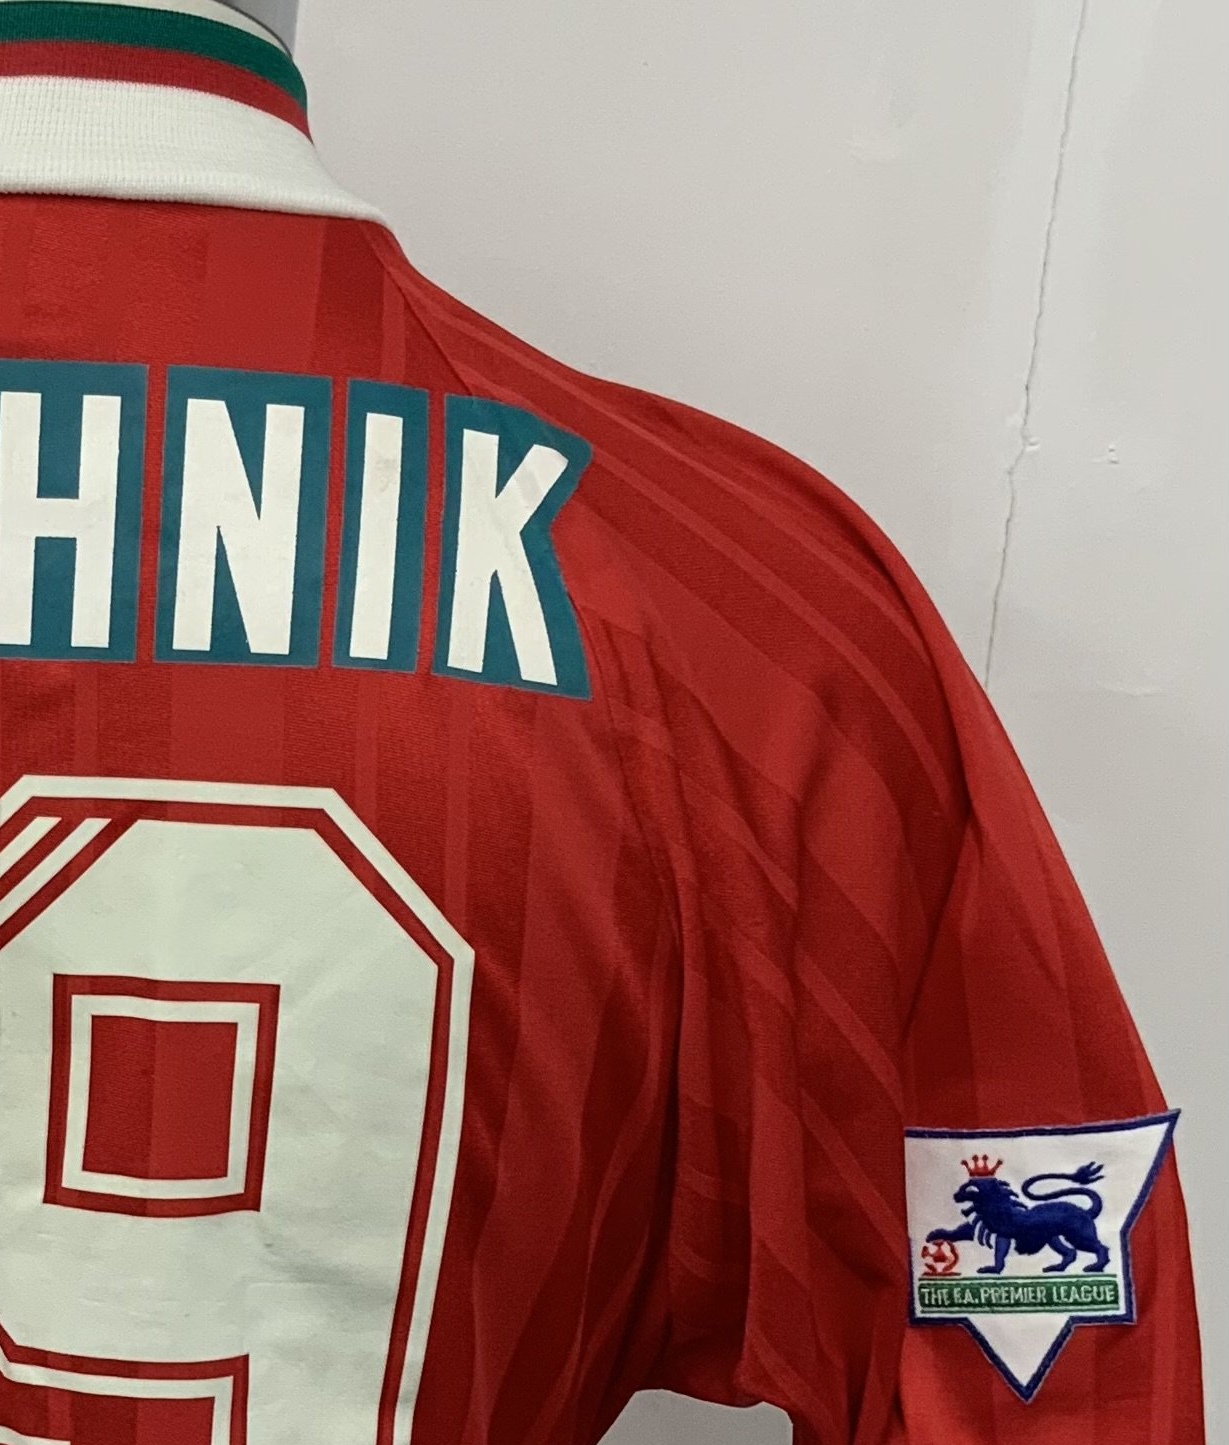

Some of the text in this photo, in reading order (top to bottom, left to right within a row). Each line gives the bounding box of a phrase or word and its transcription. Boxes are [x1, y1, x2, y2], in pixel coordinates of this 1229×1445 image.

[920, 1287, 950, 1305] THE
[980, 1286, 1047, 1304] PREMIER
[1052, 1284, 1116, 1303] LEAGUE
